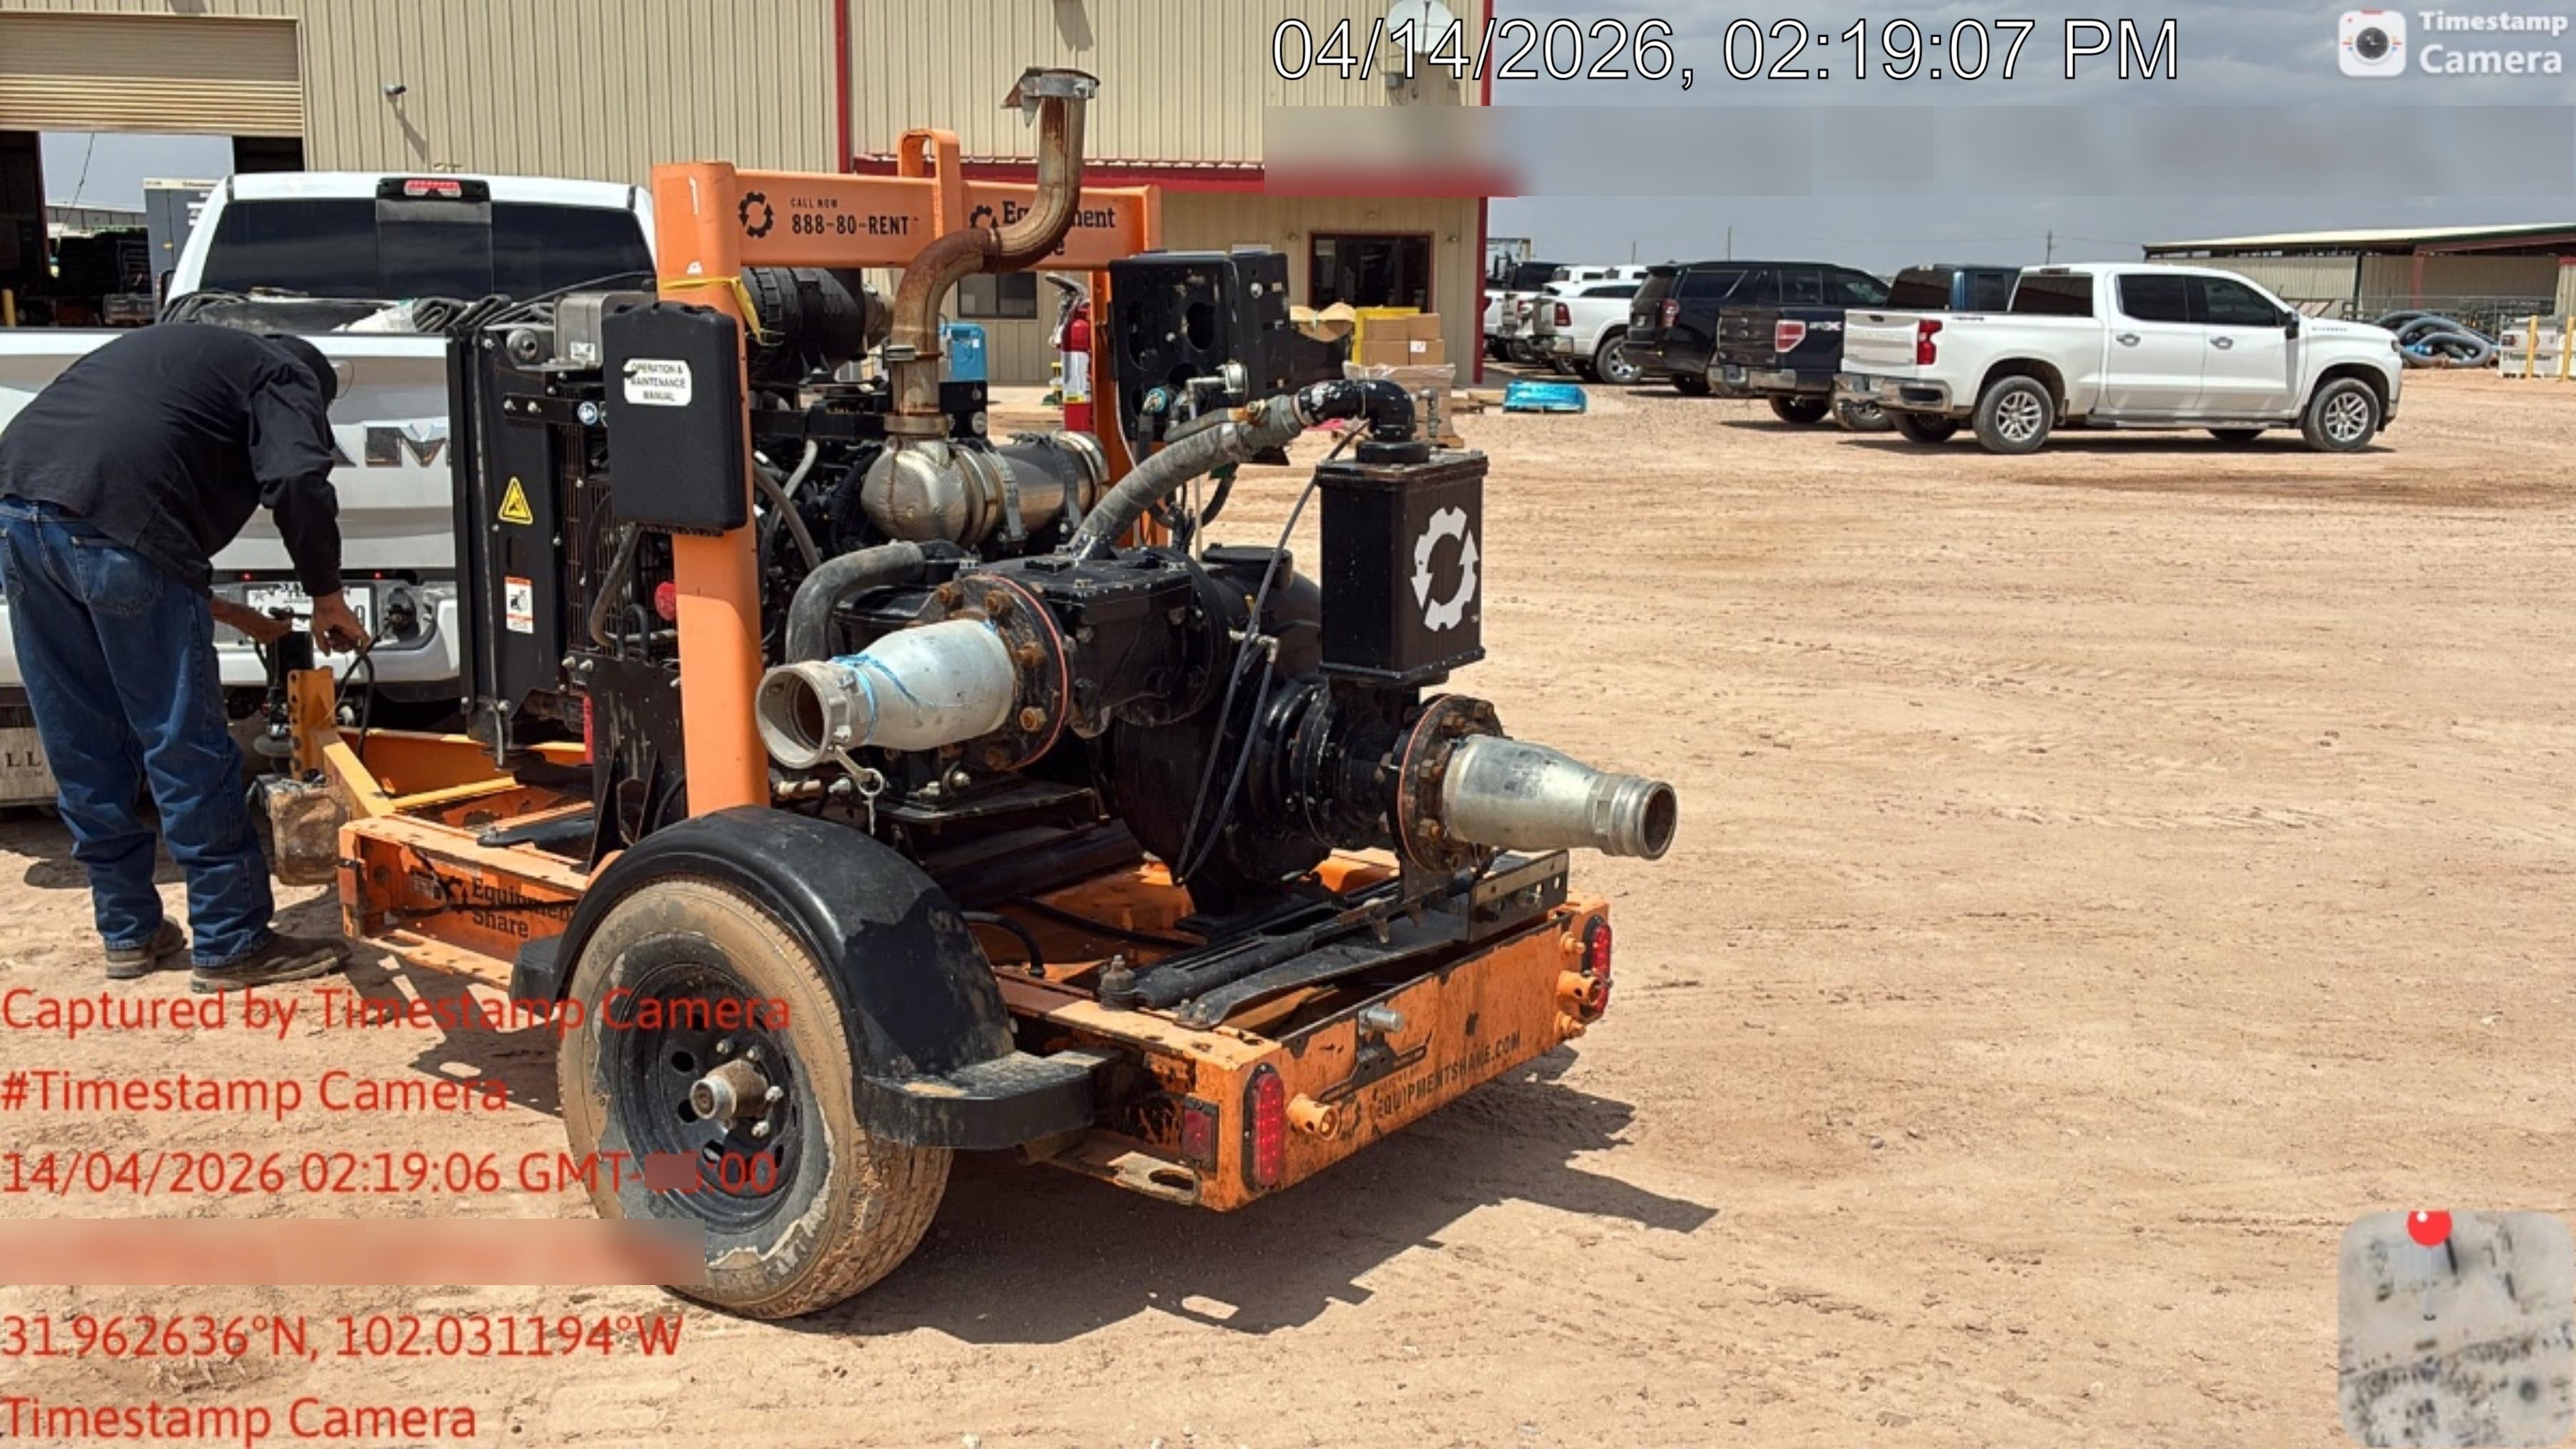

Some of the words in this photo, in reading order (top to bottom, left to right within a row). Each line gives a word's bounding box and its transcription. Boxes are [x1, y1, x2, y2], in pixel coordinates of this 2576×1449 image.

[789, 197, 814, 209] CALL
[816, 199, 838, 209] NOW
[791, 214, 909, 235] 888-80-RENT
